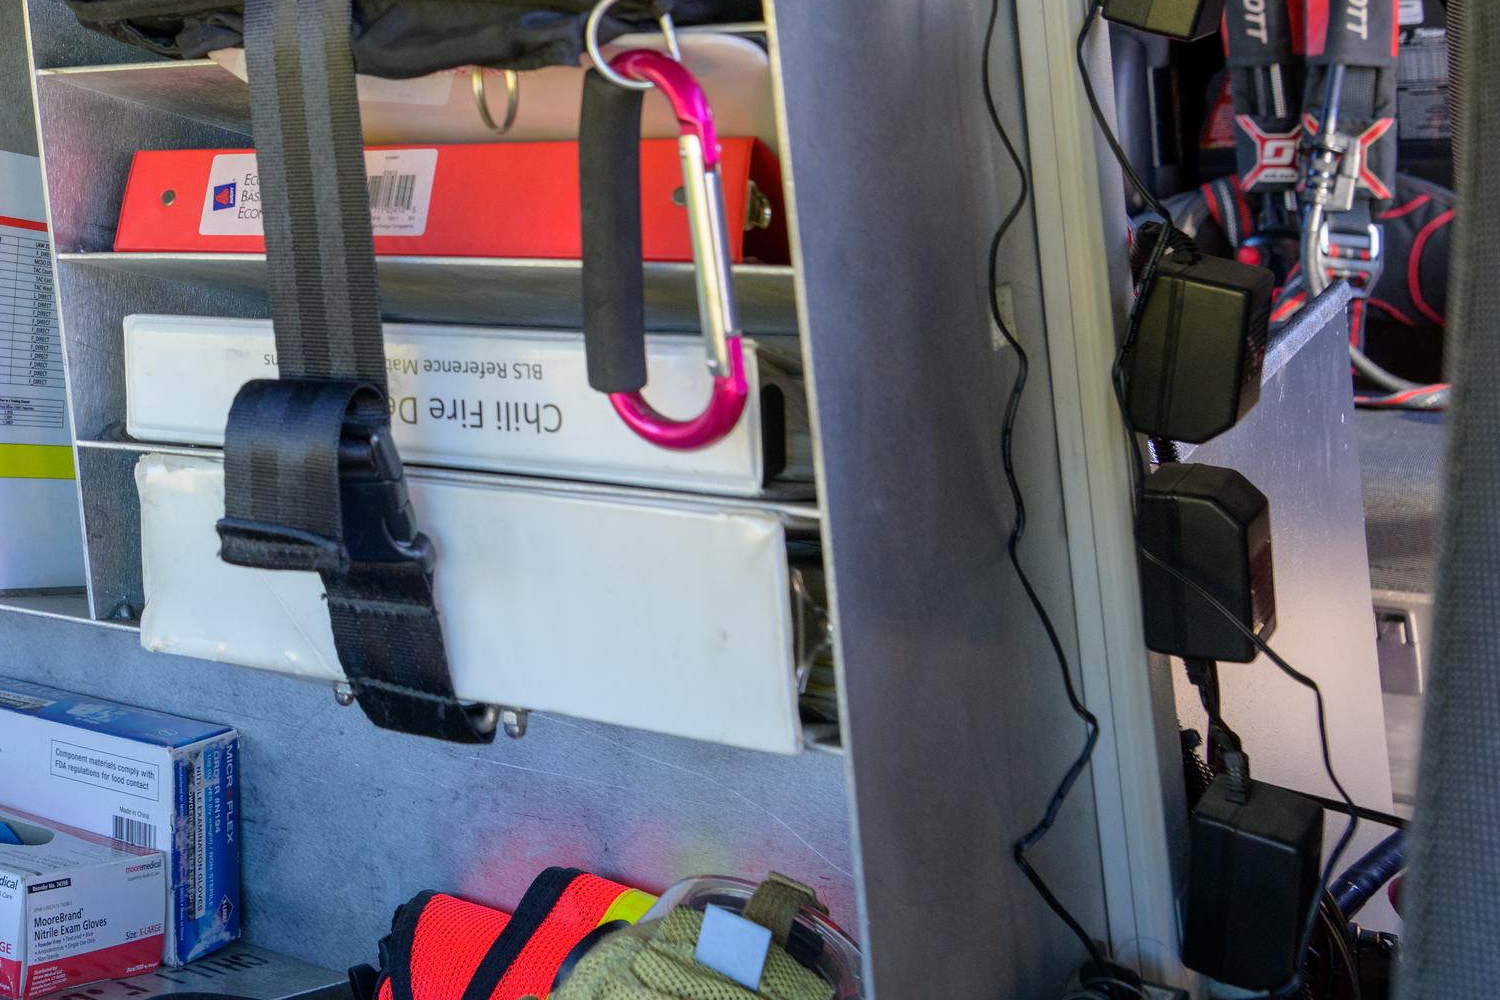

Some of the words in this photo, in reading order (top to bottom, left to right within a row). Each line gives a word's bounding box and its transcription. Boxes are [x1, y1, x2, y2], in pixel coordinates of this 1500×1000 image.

[386, 359, 418, 375] Mat
[423, 359, 508, 380] Reference
[513, 362, 543, 380] BLS
[390, 397, 418, 424] De
[429, 397, 483, 430] Fire
[496, 402, 562, 433] Chili
[55, 747, 88, 765] Component
[88, 755, 116, 771] materials
[117, 763, 139, 778] comply
[140, 769, 155, 780] with
[55, 759, 67, 770] FDA
[67, 763, 100, 780] regulations
[101, 770, 110, 782] for
[111, 772, 124, 785] food
[125, 776, 149, 791] contact
[119, 805, 131, 814] Made
[136, 809, 150, 819] China
[34, 908, 82, 928] MooreBrand
[34, 926, 59, 942] Nitrile
[60, 923, 81, 936] Exam
[82, 916, 107, 931] Gloves
